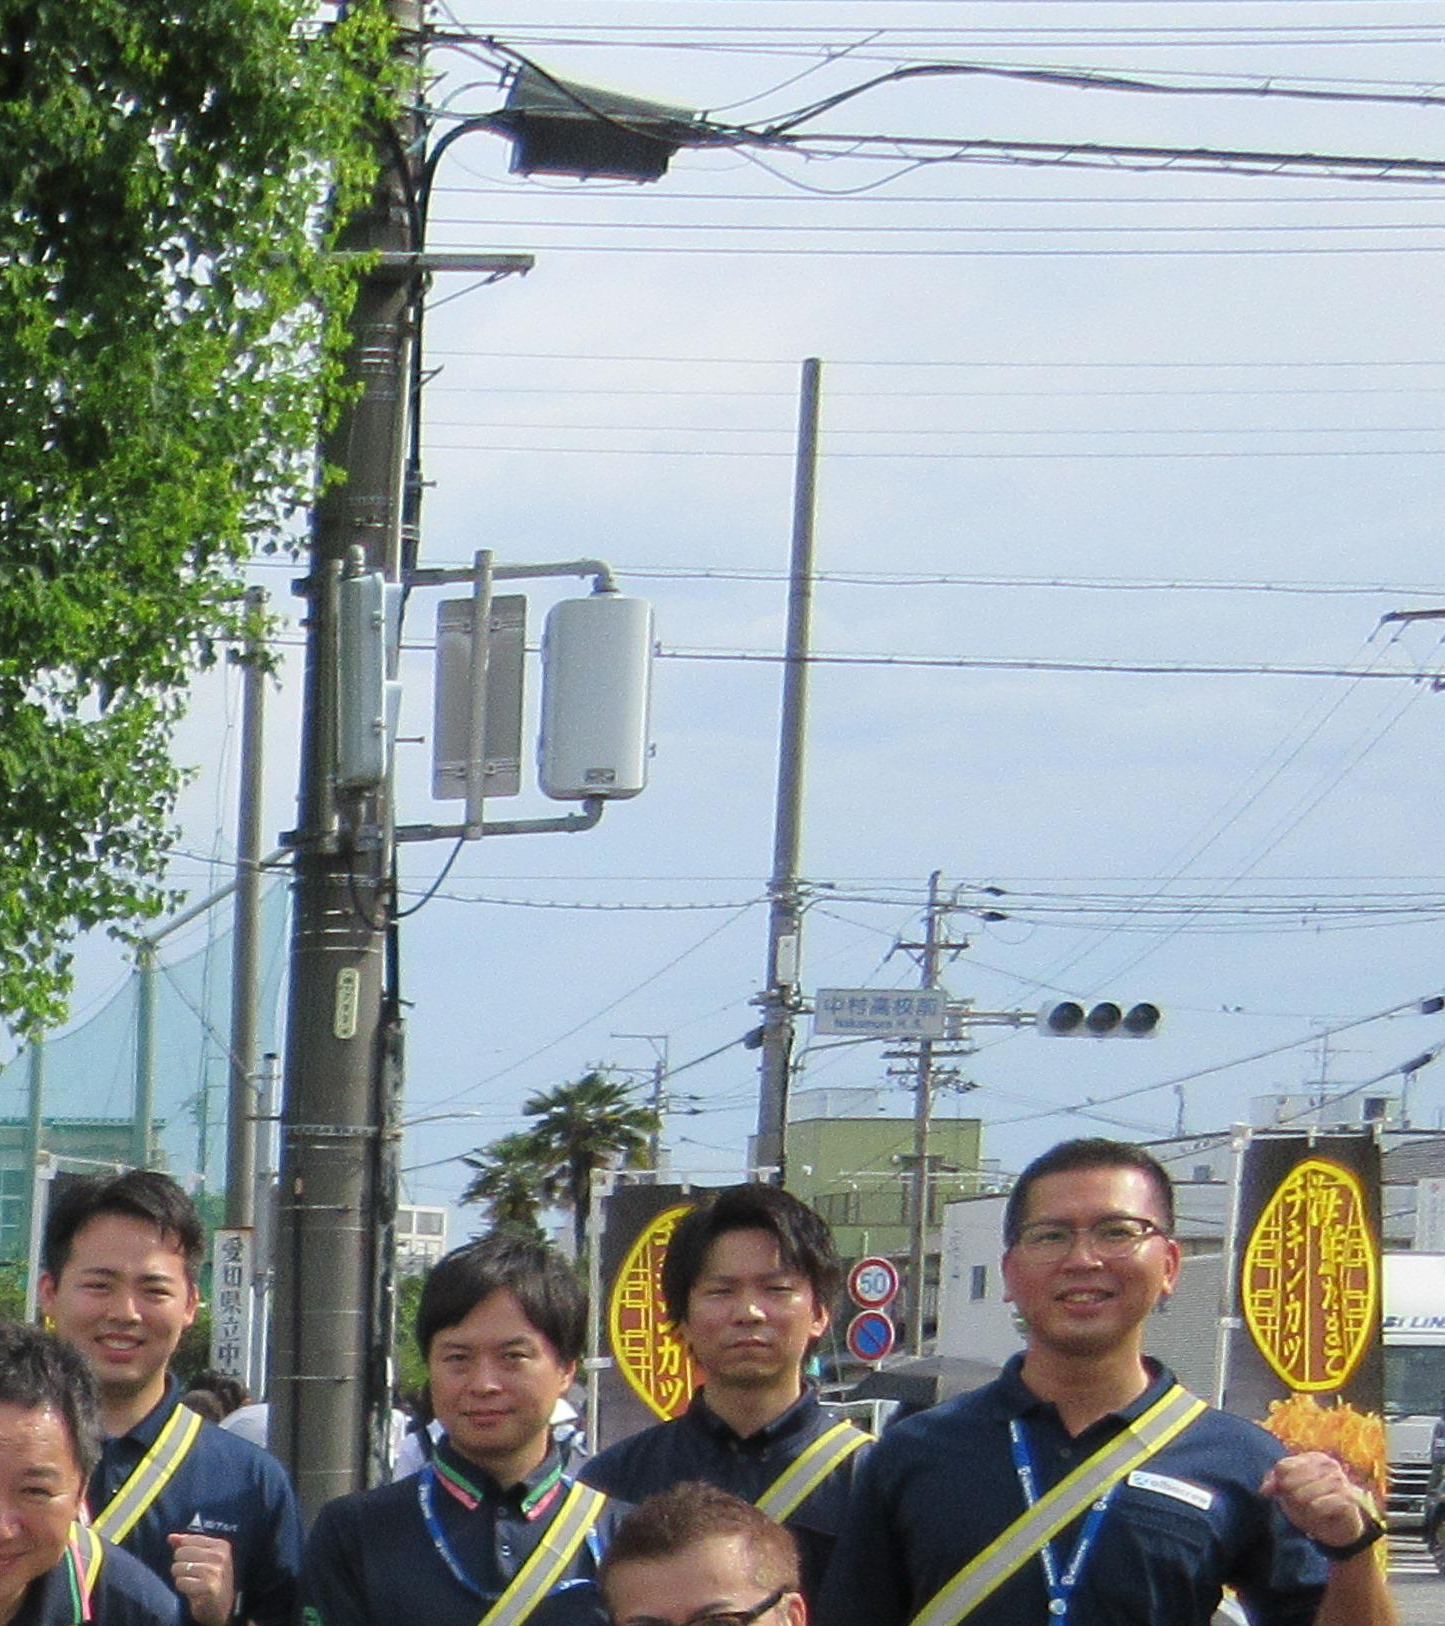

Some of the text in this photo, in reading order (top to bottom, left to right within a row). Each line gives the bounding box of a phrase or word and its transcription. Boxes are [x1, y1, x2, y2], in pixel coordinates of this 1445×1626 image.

[859, 1272, 888, 1295] 50
[1283, 1175, 1306, 1373] チキンカツ
